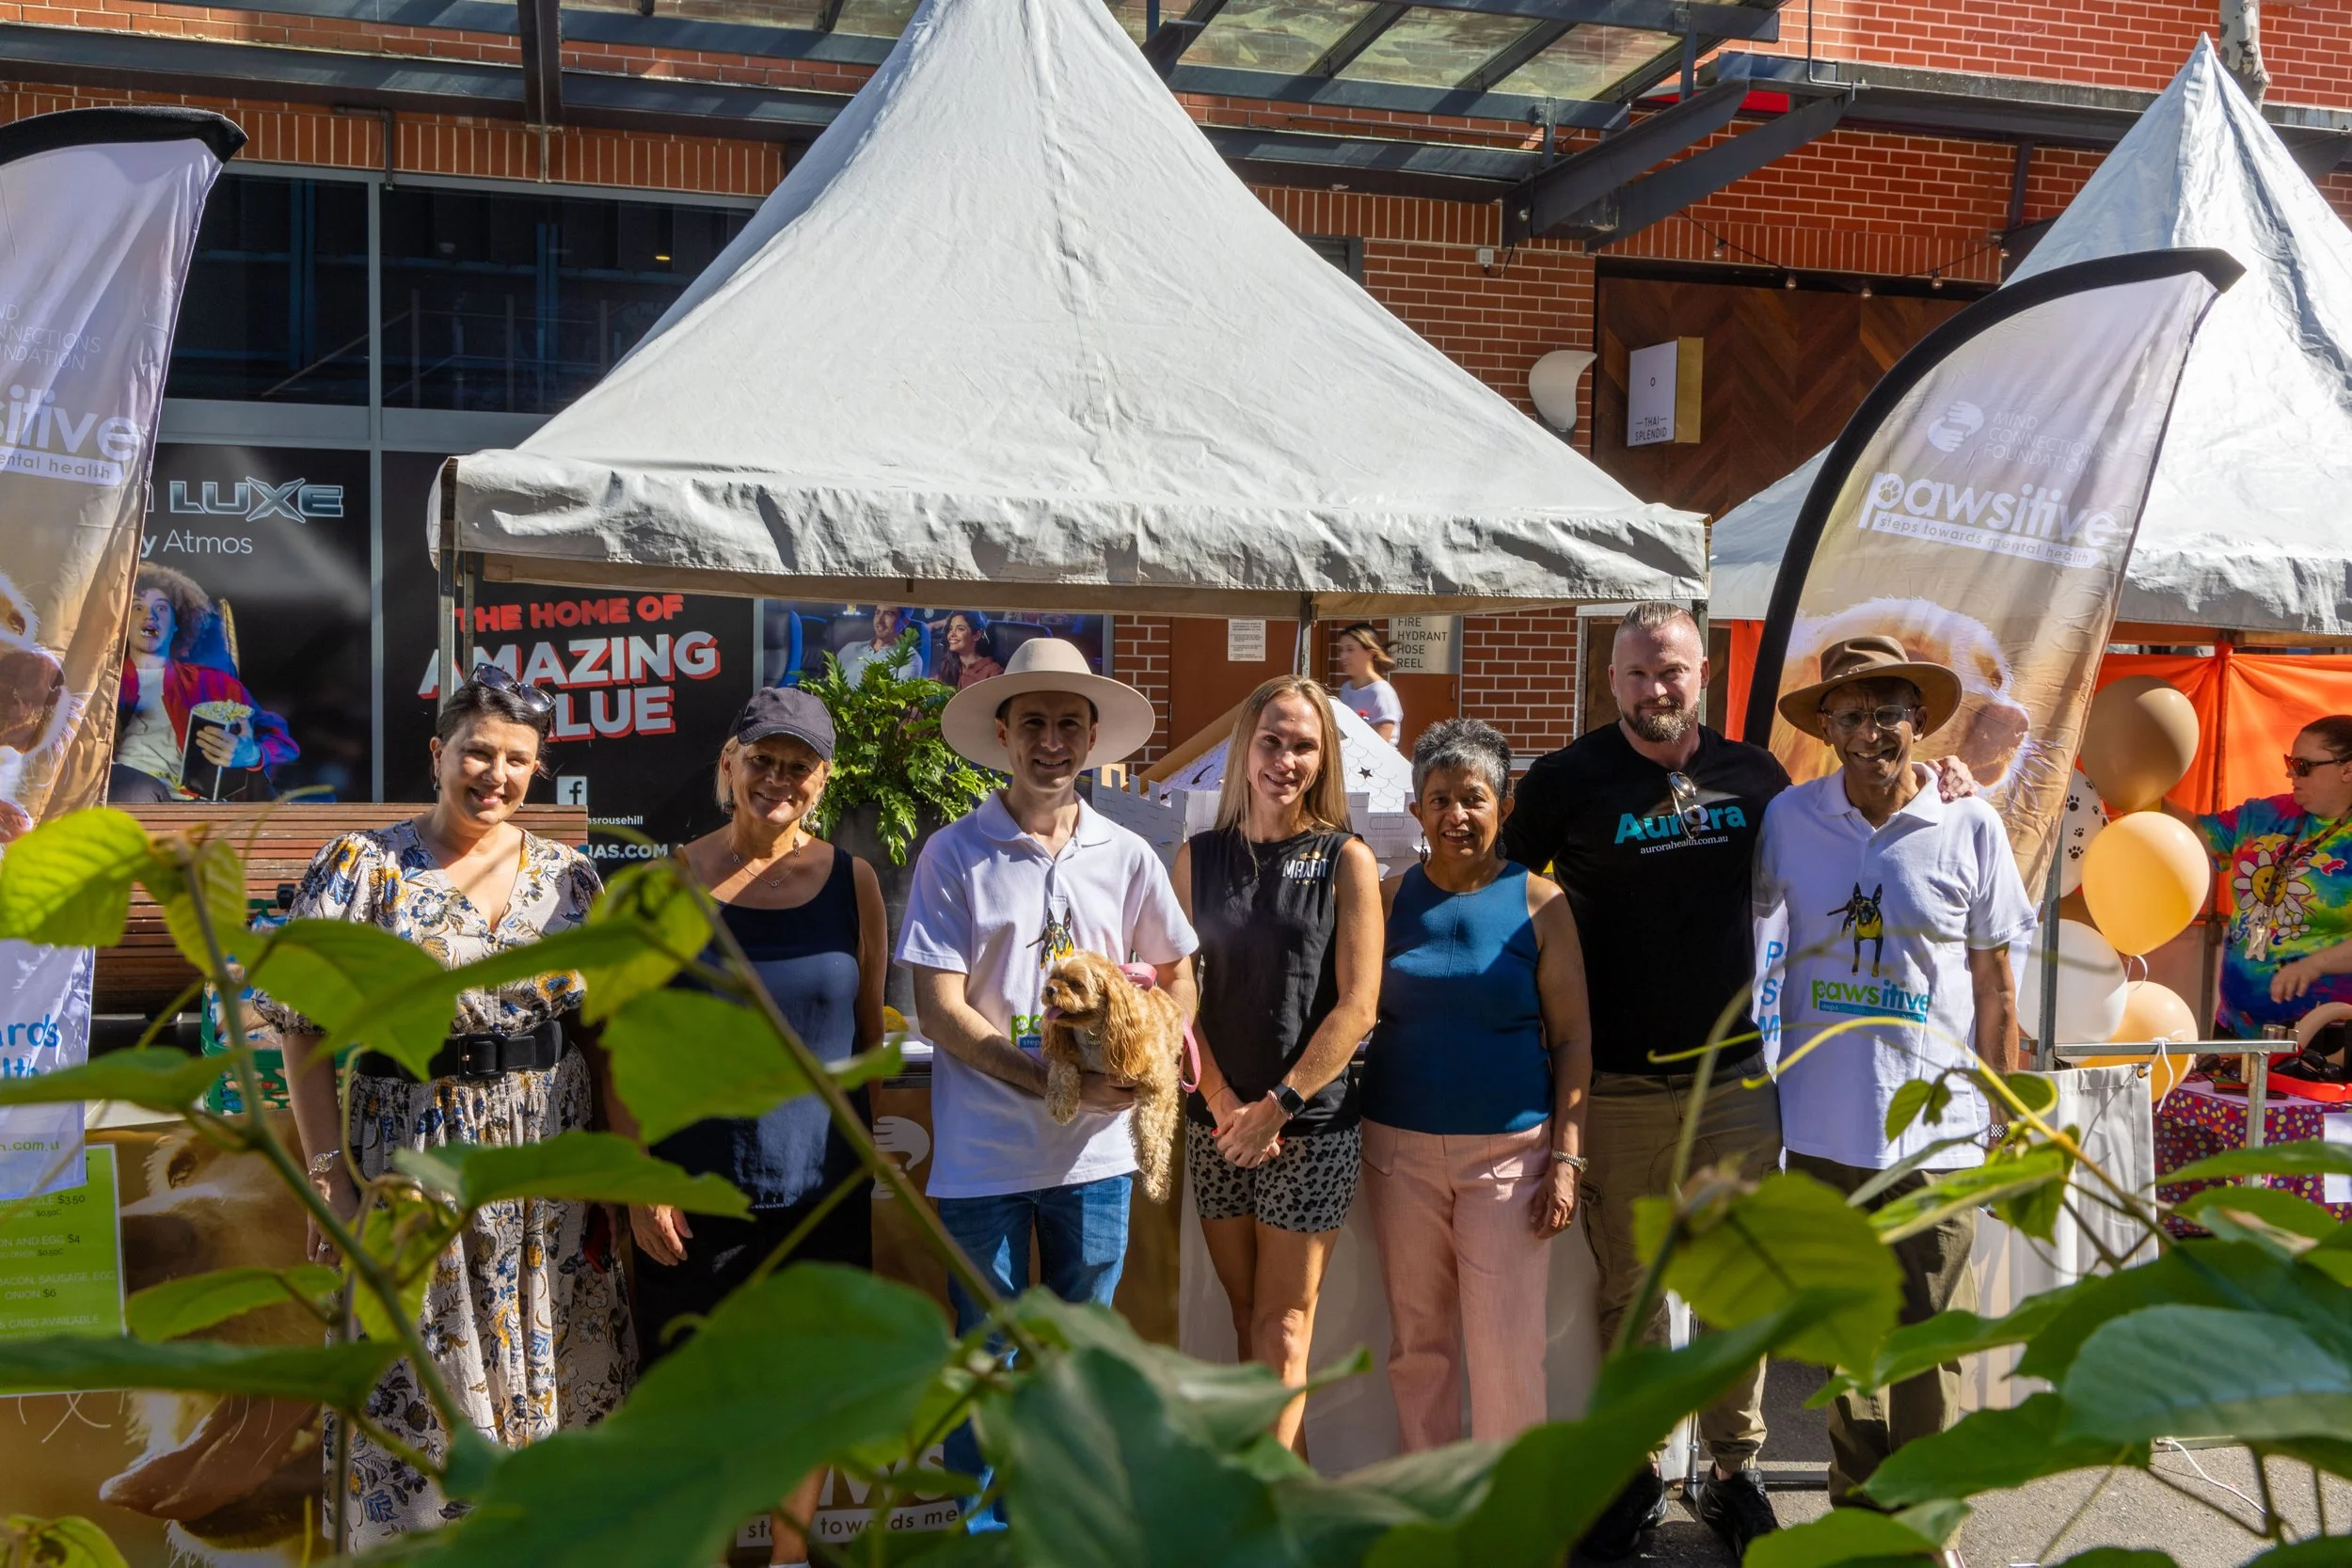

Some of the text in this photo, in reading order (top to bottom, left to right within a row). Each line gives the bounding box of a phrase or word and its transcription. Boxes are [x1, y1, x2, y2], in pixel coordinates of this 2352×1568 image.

[0, 344, 86, 372] NDATION
[1634, 427, 1667, 441] SPLENDID
[1644, 416, 1660, 428] THAI
[1993, 411, 2039, 430] MIND
[1988, 427, 2105, 460] CONNECTIONS
[49, 459, 110, 480] health
[1982, 443, 2093, 475] FOUNDATION
[169, 476, 343, 523] LUXE
[1858, 472, 2121, 546] pawsitive
[163, 529, 253, 554] Atmos
[1879, 516, 2089, 563] steps towards mental health
[530, 597, 630, 628] HOME
[636, 594, 684, 621] OF
[1398, 617, 1422, 626] FIRE
[1397, 644, 1425, 654] HOSE
[1398, 631, 1448, 641] HYDRANT
[1397, 657, 1423, 668] REEL
[546, 686, 676, 743] LUE
[1614, 804, 1747, 844] Aurora
[1811, 978, 1931, 1012] pawsitive
